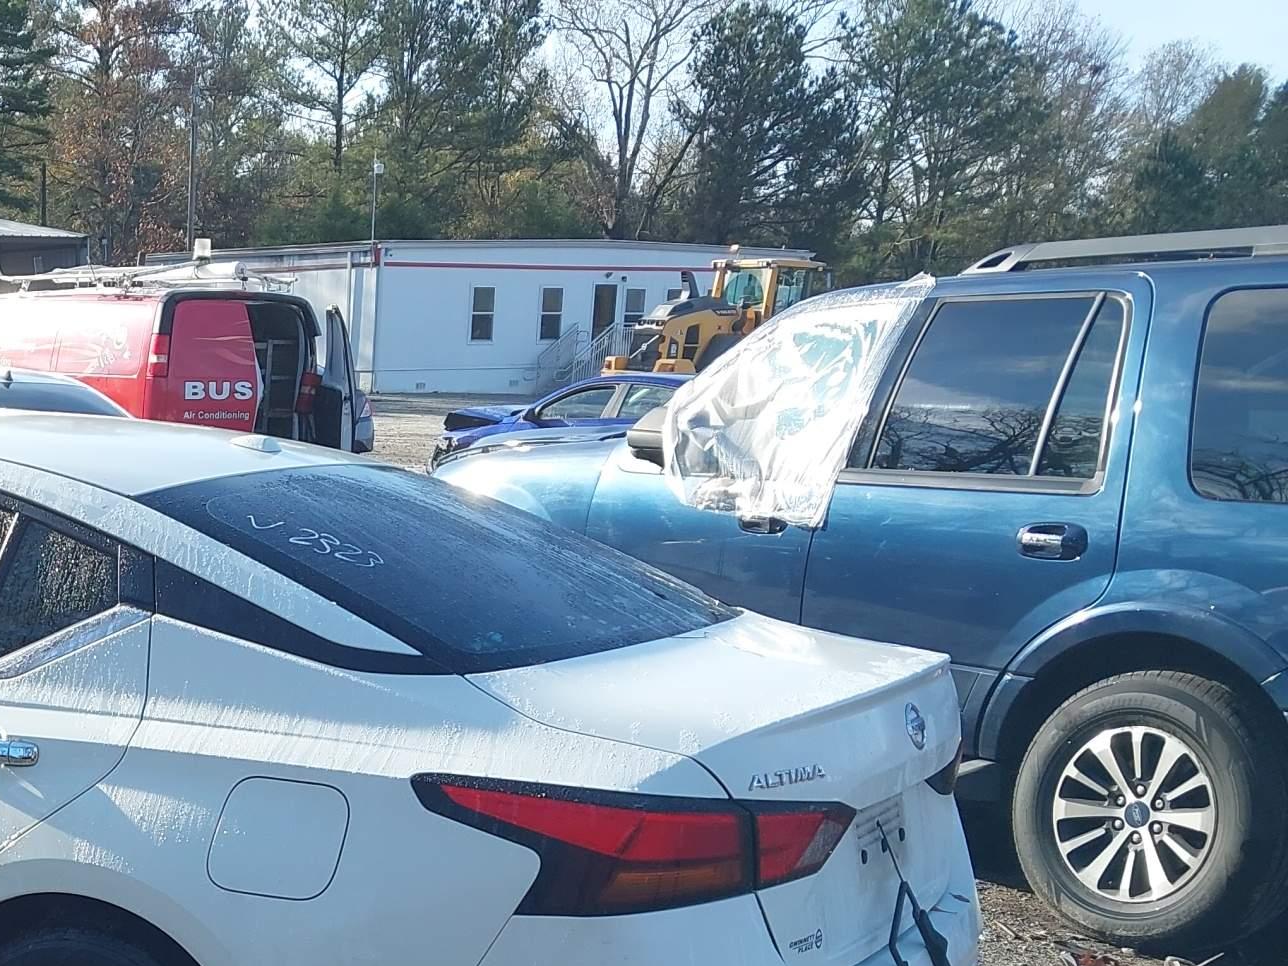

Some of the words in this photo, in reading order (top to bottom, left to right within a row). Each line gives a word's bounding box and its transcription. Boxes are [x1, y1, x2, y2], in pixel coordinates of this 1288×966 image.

[184, 380, 254, 401] BUS
[183, 410, 196, 420] Air
[198, 410, 250, 421] Conditioning
[288, 527, 385, 568] 2323
[748, 763, 827, 792] ALTIMA
[797, 941, 814, 955] PLACE
